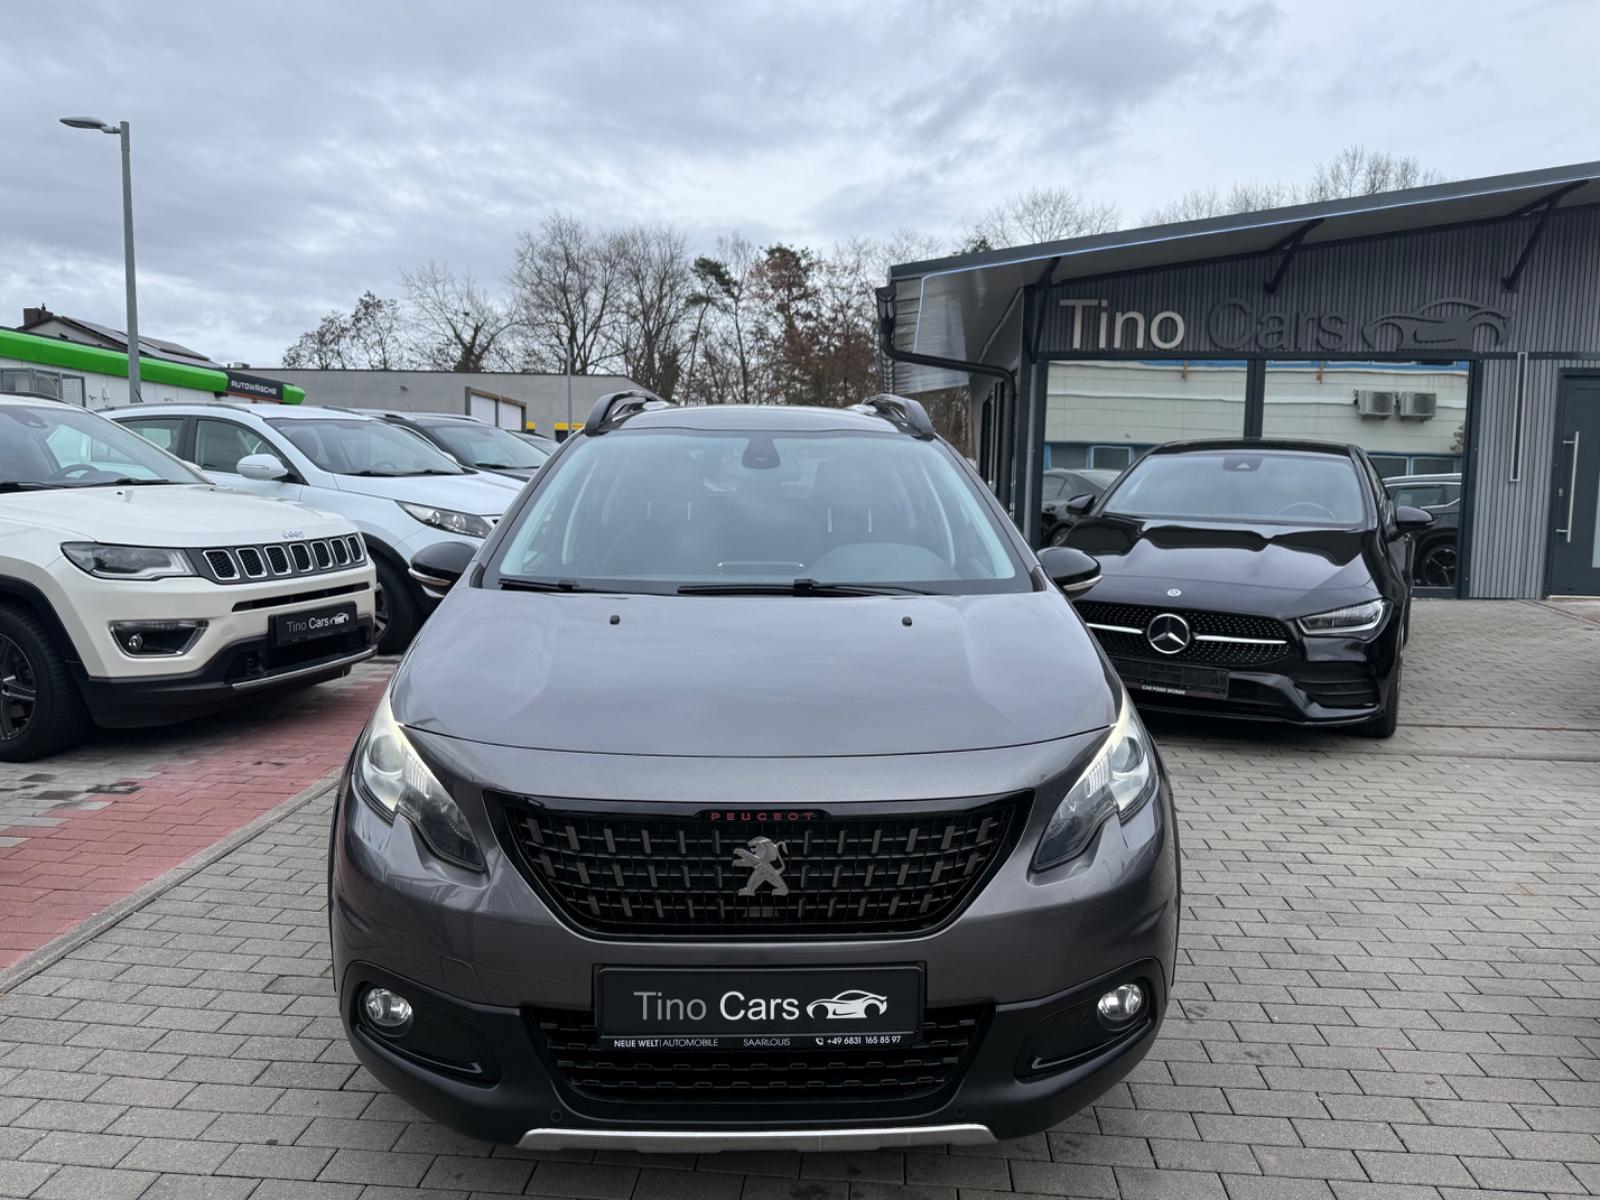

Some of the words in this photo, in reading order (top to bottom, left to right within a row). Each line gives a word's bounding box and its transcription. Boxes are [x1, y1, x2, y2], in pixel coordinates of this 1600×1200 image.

[1060, 299, 1185, 350] Tino
[1207, 298, 1350, 351] Cars
[286, 620, 307, 633] Tino
[308, 616, 329, 630] Cars
[710, 812, 814, 821] PEUGEOT
[633, 991, 707, 1021] Tino
[719, 990, 800, 1021] Cars
[614, 1039, 636, 1048] NEUE
[638, 1039, 659, 1048] WELT
[662, 1038, 719, 1047] AUTOMOBILE
[743, 1038, 791, 1047] SAARLOUIS
[826, 1036, 842, 1045] +49
[843, 1036, 862, 1045] 6831
[865, 1035, 878, 1044] 165
[879, 1035, 890, 1044] 85
[891, 1035, 902, 1044] 97
